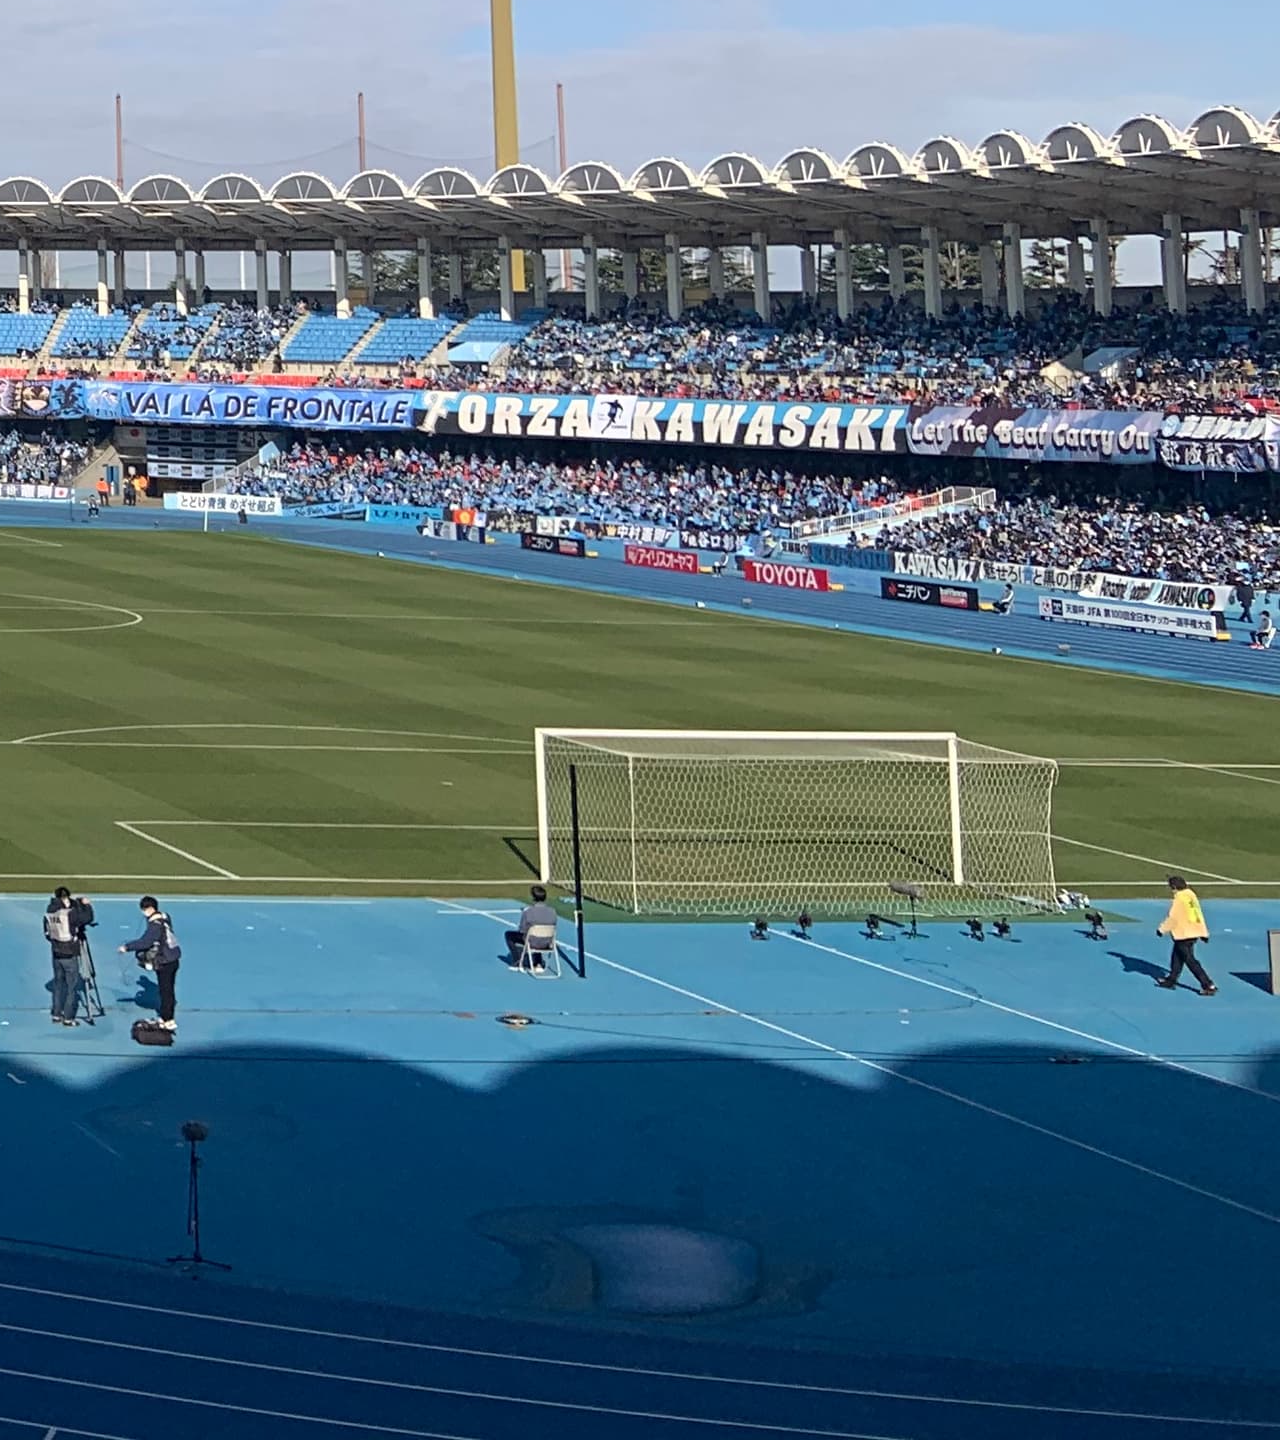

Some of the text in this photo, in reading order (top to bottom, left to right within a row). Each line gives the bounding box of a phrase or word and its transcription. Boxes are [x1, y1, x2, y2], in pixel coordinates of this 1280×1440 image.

[125, 390, 173, 415] VAI
[223, 394, 257, 420] DE
[267, 396, 409, 426] FRONTALE
[632, 400, 905, 451] KAWASAKI
[911, 417, 1150, 455] Let The Beat Carry On
[637, 546, 695, 571] アイリスオーヤマ
[894, 551, 975, 583] KAWASAKI
[752, 562, 819, 590] TOYOTA
[1087, 606, 1102, 618] JFA
